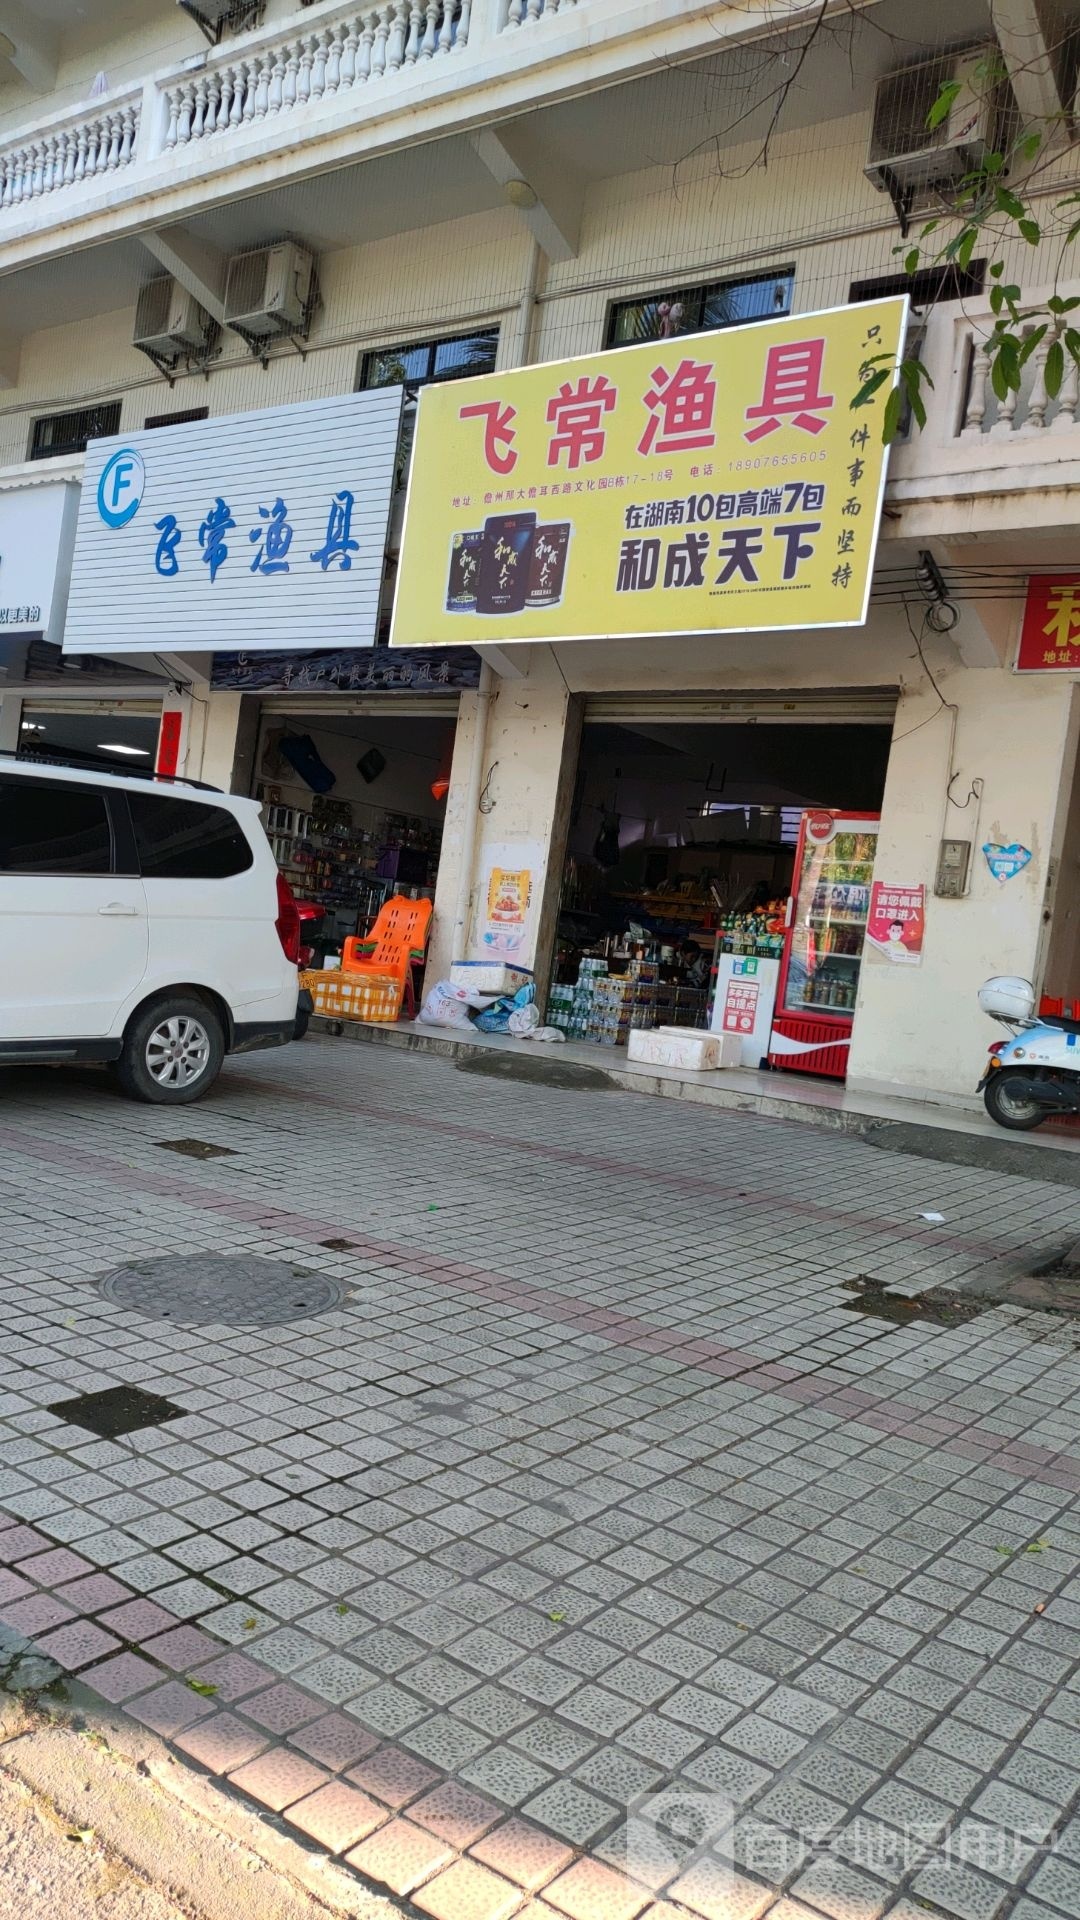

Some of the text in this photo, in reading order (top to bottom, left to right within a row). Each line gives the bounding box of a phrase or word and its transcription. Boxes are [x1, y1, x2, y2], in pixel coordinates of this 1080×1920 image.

[459, 338, 834, 475] 飞常渔具
[112, 463, 133, 506] F
[625, 482, 825, 529] 在湖南10包高端7包
[154, 490, 359, 584] 飞常渔具
[616, 523, 821, 591] 和成天下
[281, 661, 450, 686] 寻找户外最美丽的风景
[875, 908, 920, 921] 口罩进入
[877, 895, 922, 907] 请您佩戴
[727, 998, 756, 1011] 自提点
